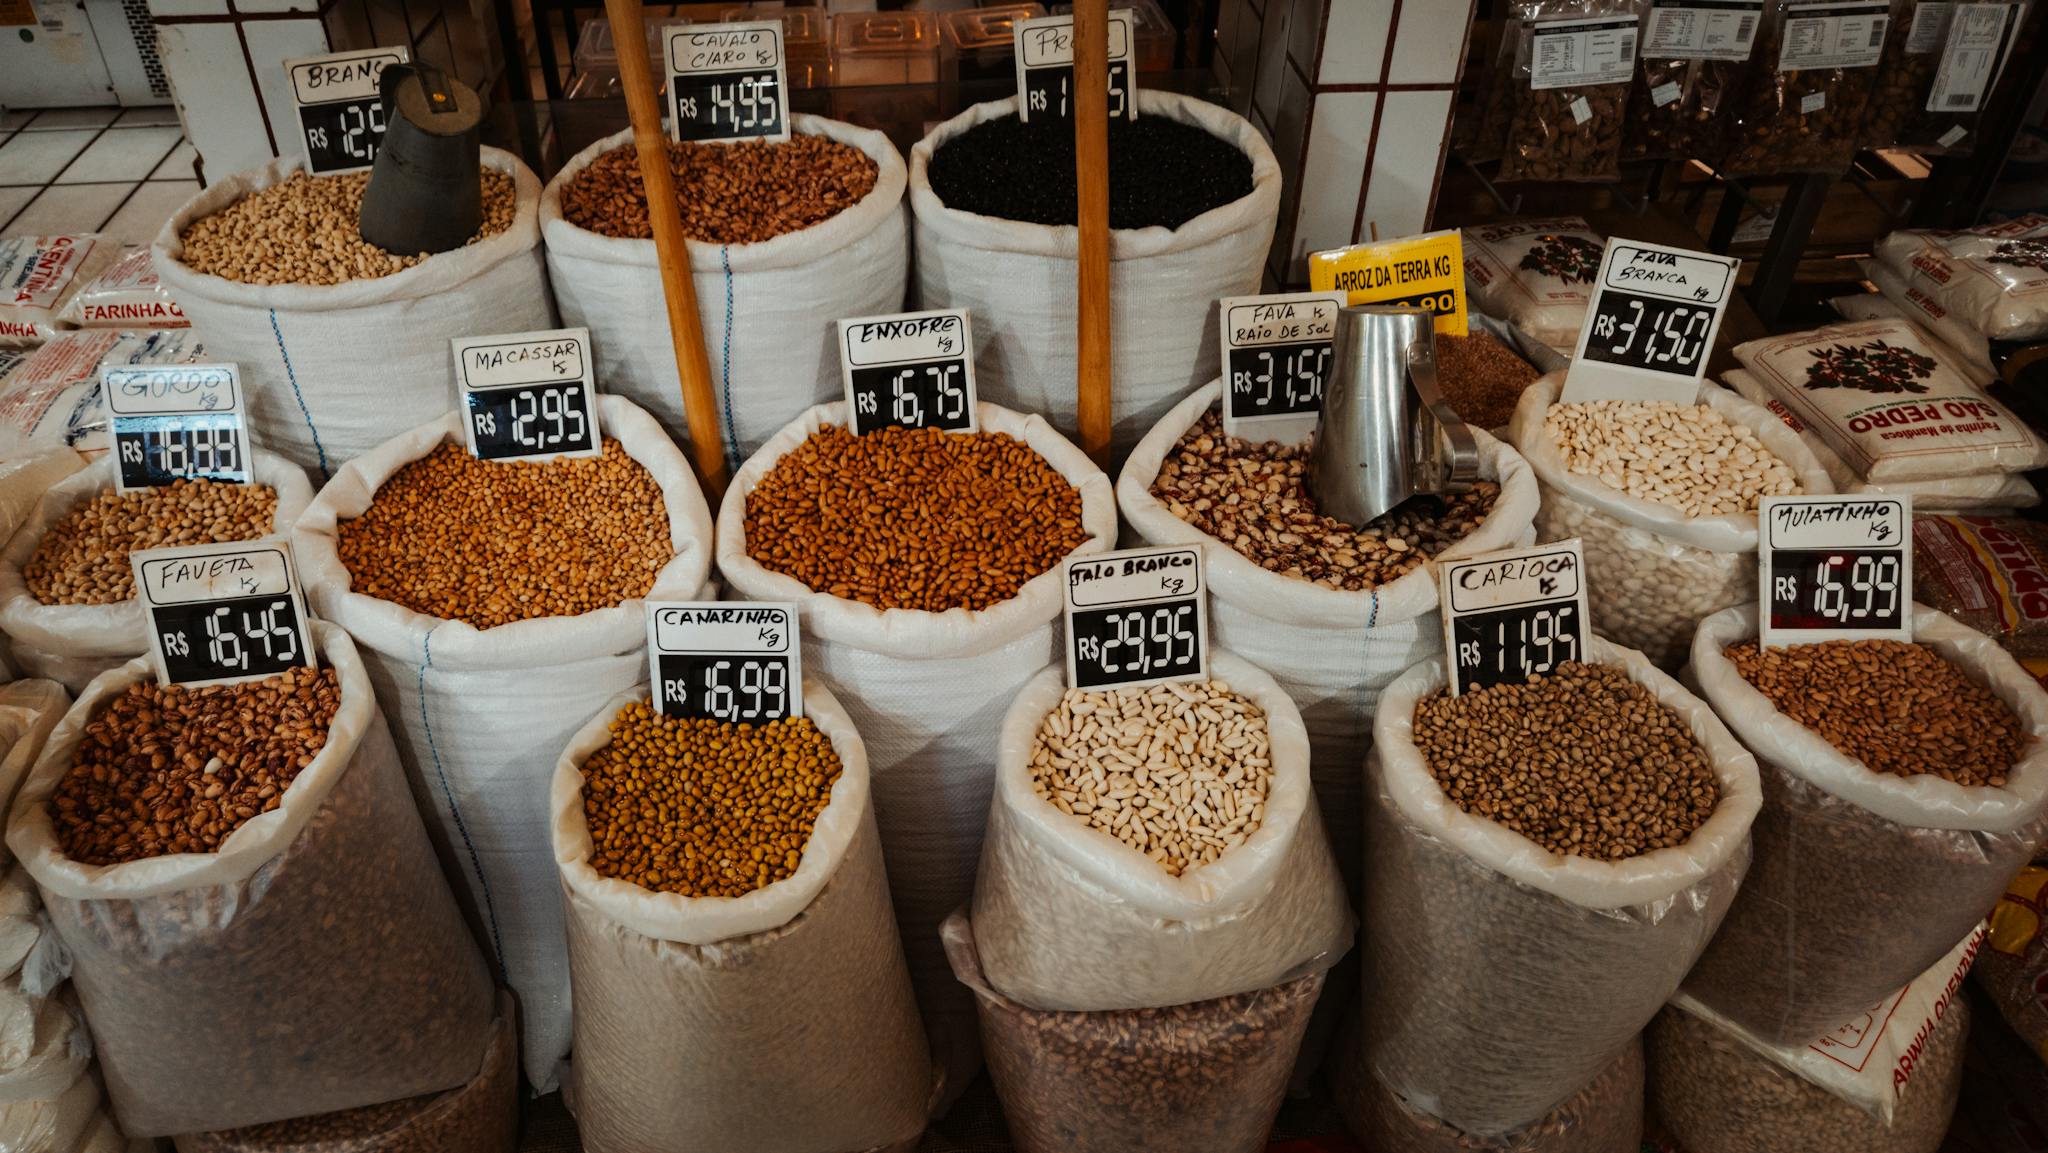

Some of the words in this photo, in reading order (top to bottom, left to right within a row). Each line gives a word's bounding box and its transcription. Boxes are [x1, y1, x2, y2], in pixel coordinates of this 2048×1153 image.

[691, 32, 760, 47] CAVALO
[308, 60, 382, 89] BRANC
[680, 96, 698, 120] R$
[711, 75, 776, 133] 14,95
[1030, 88, 1047, 112] R$
[308, 126, 328, 150] R$
[340, 103, 386, 160] 12,9
[1630, 249, 1677, 267] FAVA
[1335, 268, 1374, 292] ARROZ
[1375, 265, 1392, 287] DA
[1394, 258, 1432, 284] TERRA
[1434, 255, 1450, 277] KG
[1616, 266, 1687, 285] BRANCA
[85, 303, 166, 320] FARINHA
[1254, 302, 1296, 323] FAVA
[861, 317, 957, 342] ENXOFRE
[1278, 325, 1300, 338] DE
[1594, 314, 1617, 339] R$
[1612, 300, 1710, 365] 31,50
[475, 342, 576, 370] MACASSAR
[937, 336, 953, 352] Kg
[121, 371, 220, 399] GORDO
[1234, 369, 1253, 395] R$
[199, 392, 219, 411] Kg
[857, 390, 878, 415] R$
[893, 365, 964, 427] 16,75
[475, 411, 497, 437] R$
[511, 387, 585, 449] 12,95
[1848, 404, 1943, 434] PEDRO
[1939, 424, 1954, 433] de
[1956, 422, 2001, 434] Farinha
[1881, 426, 1939, 440] Mandioca
[122, 439, 143, 464] R$
[1867, 520, 1893, 541] Kg
[161, 557, 254, 589] FAVETA
[1121, 556, 1193, 577] BRANCO
[1459, 556, 1574, 590] CARIOCA
[1161, 576, 1184, 594] Kg
[1775, 575, 1797, 603] R$
[1813, 556, 1899, 623] 16,99
[664, 609, 784, 626] CANARINHO
[163, 630, 190, 658] R$
[205, 601, 297, 670] 16,45
[758, 627, 780, 648] Kg
[1078, 634, 1100, 662] R$
[1101, 606, 1195, 675] 29,95
[1459, 639, 1481, 667] R$
[1498, 606, 1576, 679] 11,95
[665, 678, 687, 705] R$
[704, 661, 786, 723] 16,99
